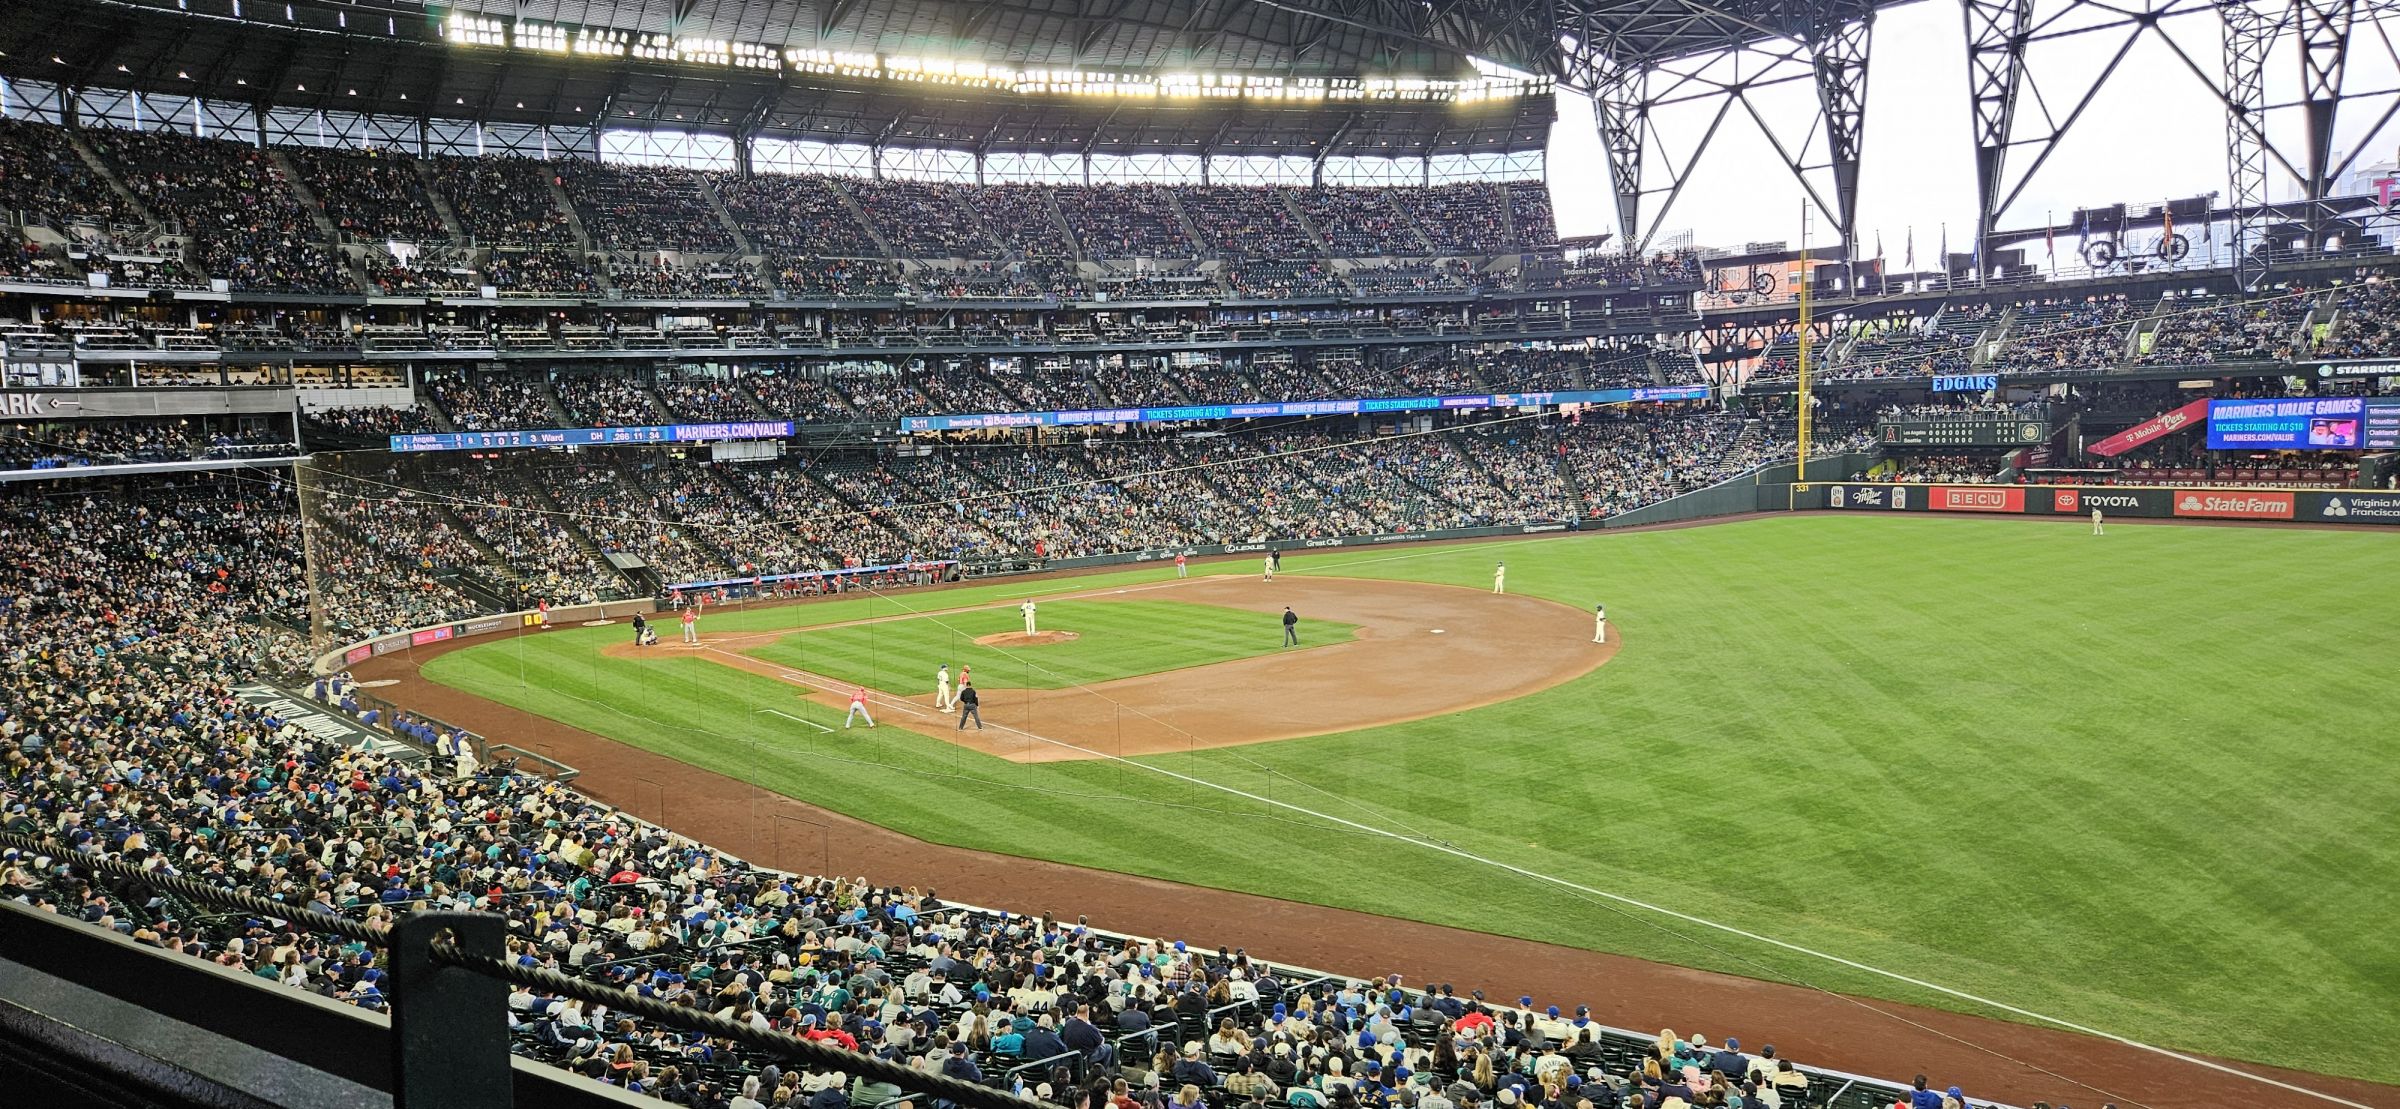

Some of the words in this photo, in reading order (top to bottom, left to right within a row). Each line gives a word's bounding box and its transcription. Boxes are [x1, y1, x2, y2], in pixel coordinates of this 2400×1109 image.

[1282, 403, 1315, 414] MARINERS
[1365, 401, 1389, 410] TICKETS
[1390, 400, 1418, 410] STARTING
[2213, 403, 2276, 420] MARINERS
[2277, 402, 2314, 416] VALUE
[2315, 400, 2362, 415] GAMES
[1147, 409, 1173, 419] TICKETS
[1174, 408, 1204, 418] STARTING
[1205, 408, 1213, 417] AT
[1213, 407, 1226, 417] $10
[911, 419, 928, 429] 3:11
[2215, 423, 2243, 432] TICKETS
[2245, 423, 2278, 432] STARTING
[2280, 423, 2289, 431] AT
[2290, 422, 2303, 432] $10
[634, 431, 642, 440] 11
[675, 422, 788, 440] MARINERS.COM/VALUE
[484, 437, 490, 446] 3
[512, 436, 519, 445] 2
[541, 433, 564, 442] Ward
[590, 431, 603, 440] DH
[2223, 433, 2295, 442] MARINERS.COM/VALUE
[1832, 488, 1843, 496] Lite
[1893, 489, 1904, 497] Lite
[1853, 491, 1882, 504] Miller
[2083, 495, 2139, 507] TOYOTA
[2351, 499, 2390, 508] Virginia
[1327, 539, 1343, 547] Clips
[1033, 1000, 1048, 1010] 44
